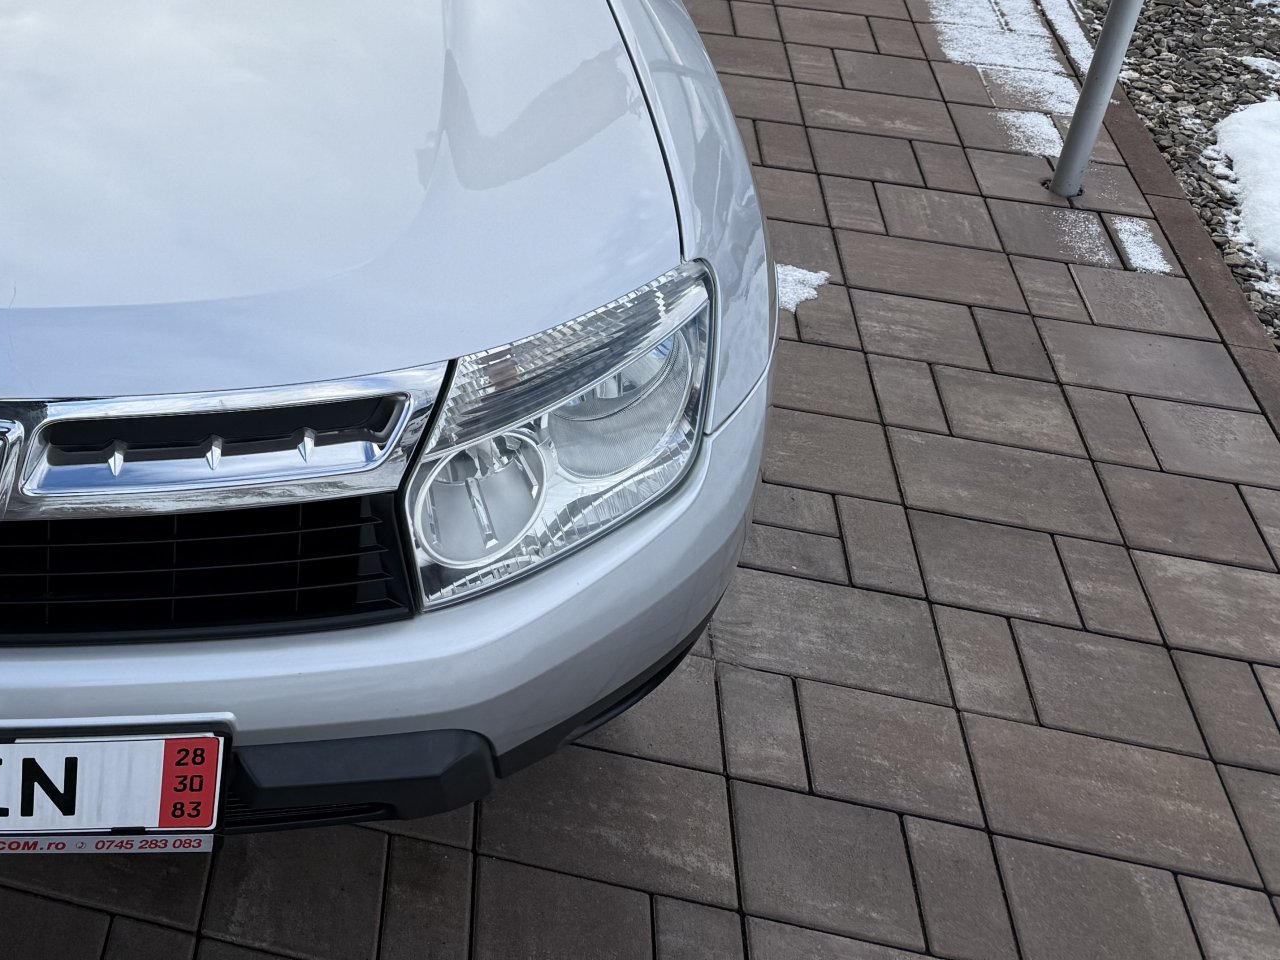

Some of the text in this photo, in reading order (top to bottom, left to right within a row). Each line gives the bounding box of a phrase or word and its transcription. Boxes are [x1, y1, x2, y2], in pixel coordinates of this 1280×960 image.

[175, 747, 206, 767] 28
[173, 774, 204, 793] 30
[171, 801, 202, 819] 83
[94, 839, 134, 851] 0745
[138, 838, 168, 850] 283
[172, 838, 203, 850] 083
